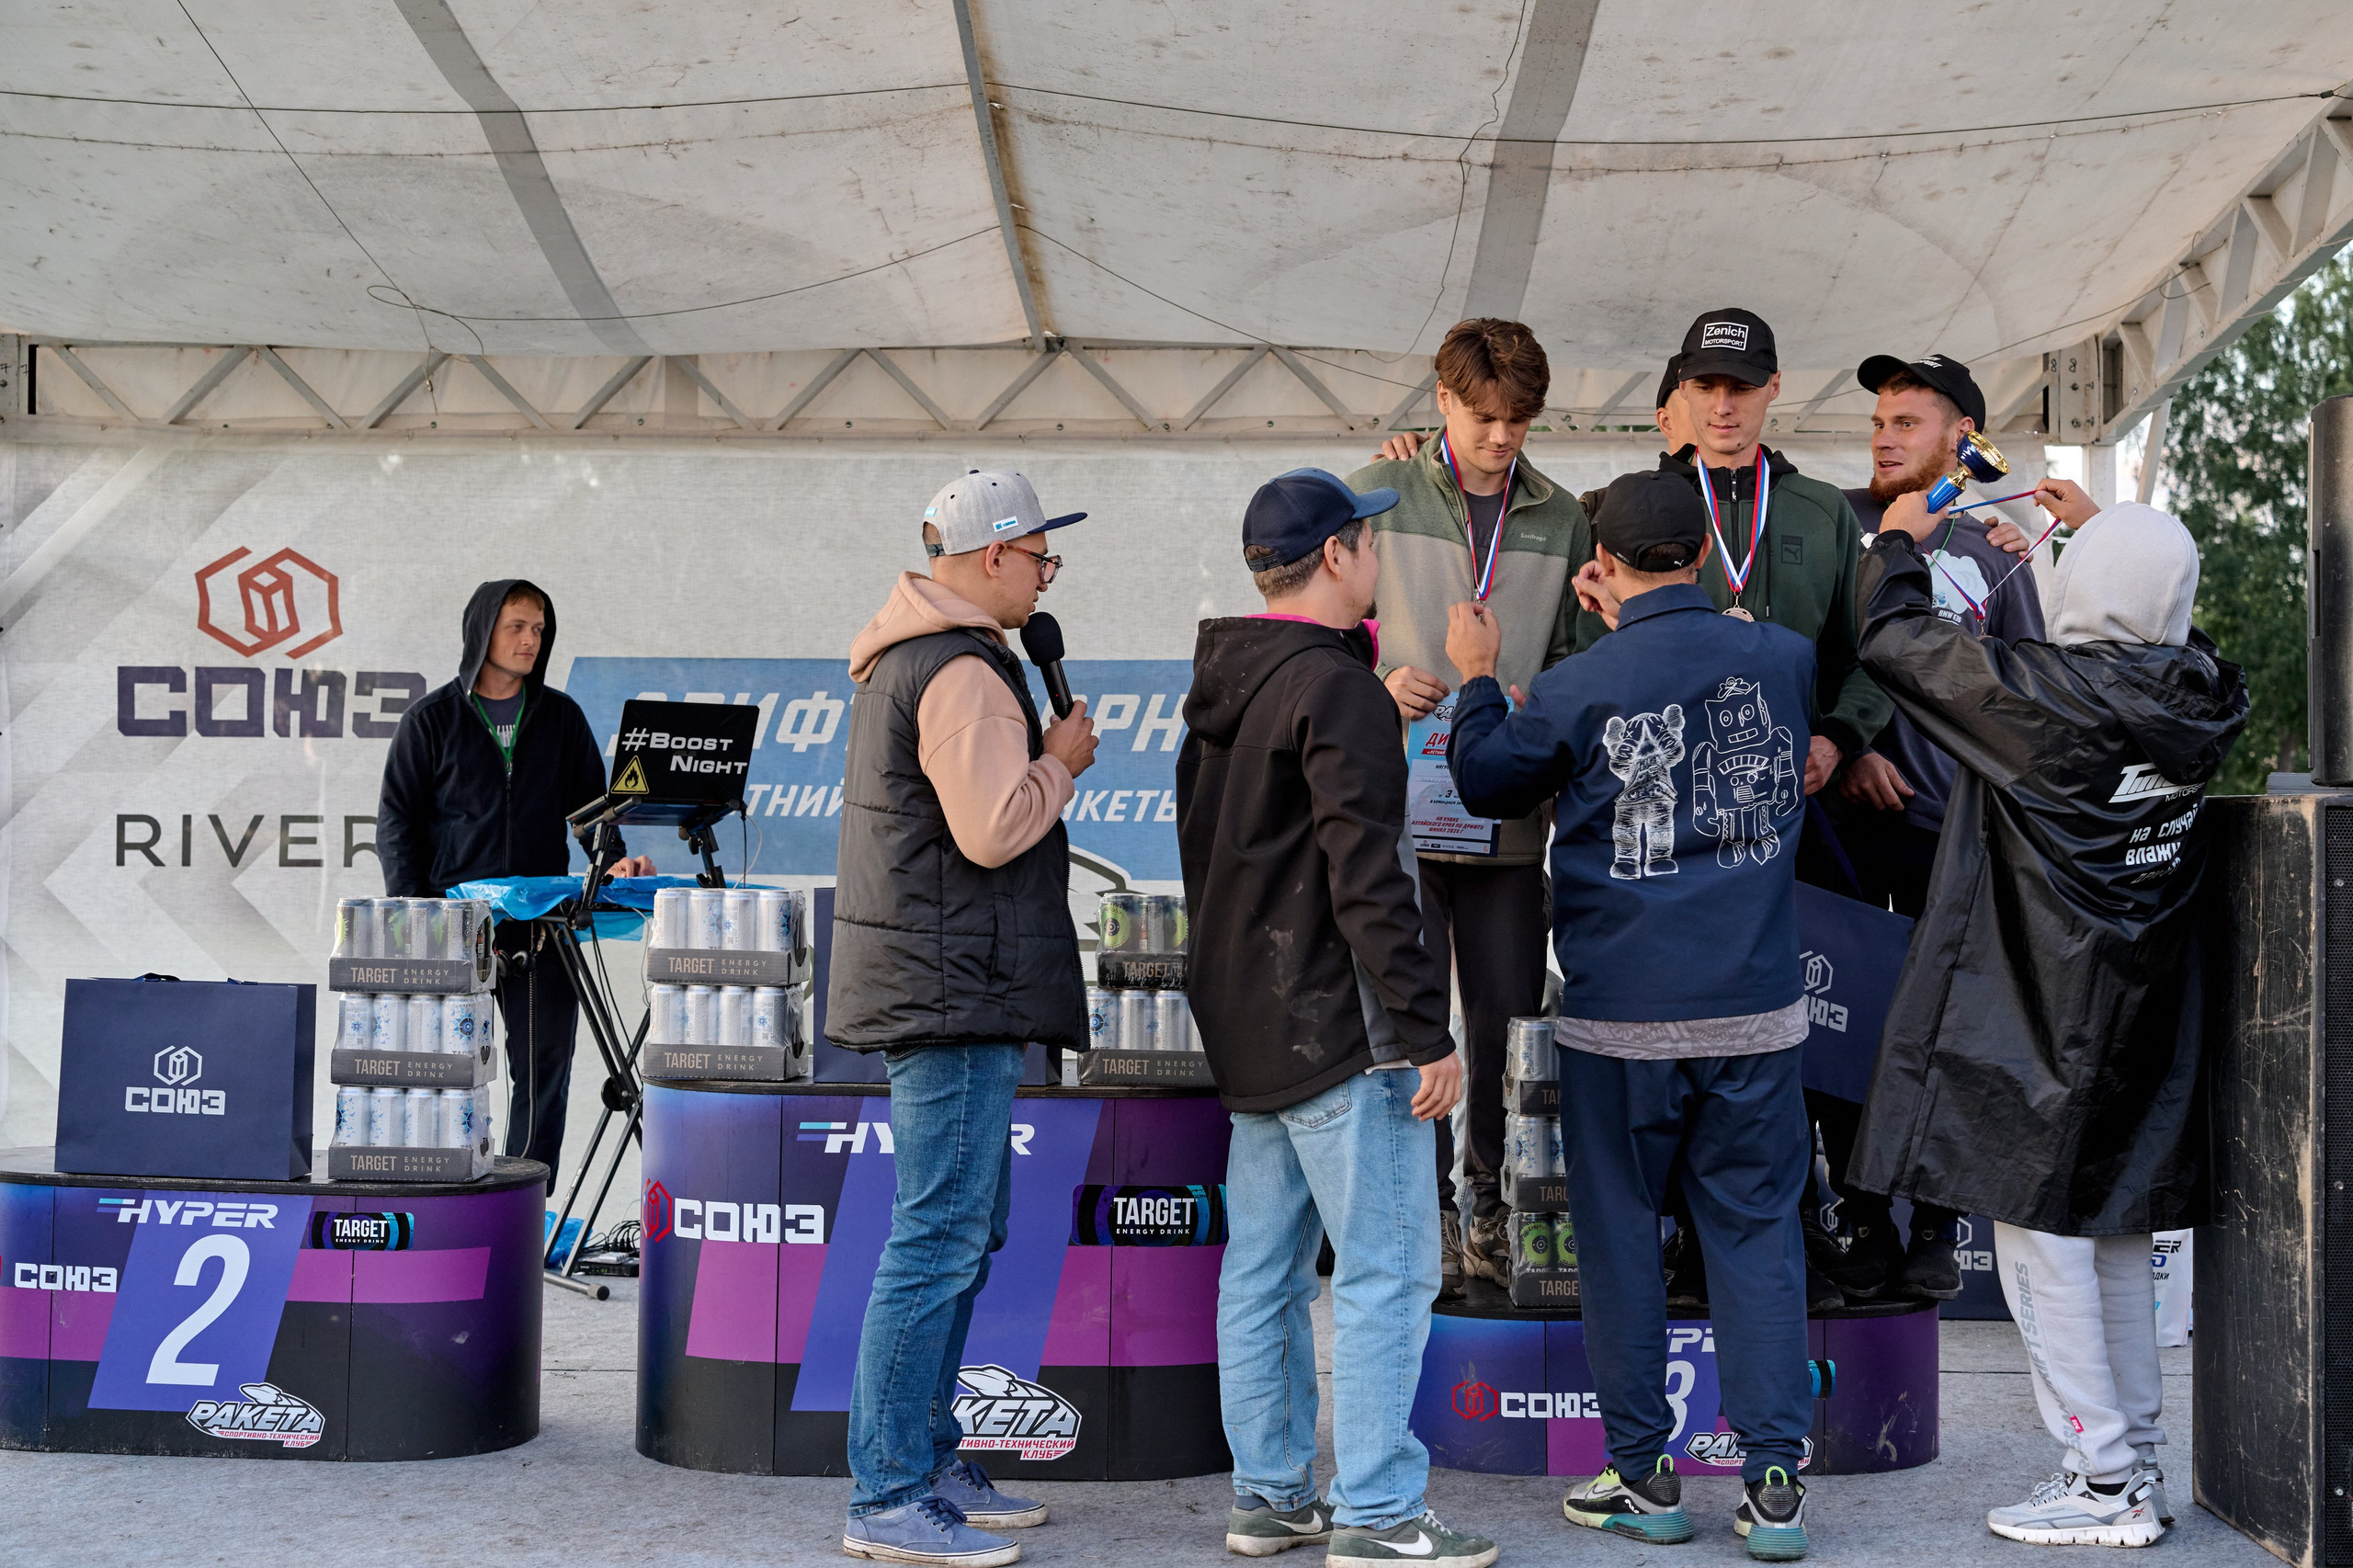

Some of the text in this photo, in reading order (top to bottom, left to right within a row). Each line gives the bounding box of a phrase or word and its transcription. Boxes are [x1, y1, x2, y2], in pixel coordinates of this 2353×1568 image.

[1706, 325, 1745, 338] Zenich
[1705, 338, 1745, 347] MOTORSPORT
[1938, 609, 1954, 620] BMW
[118, 666, 426, 738] СОЮЗ
[2129, 802, 2199, 844] на случай
[668, 957, 767, 974] TARGET ENERGY
[1123, 961, 1170, 978] TARGET
[350, 967, 397, 983] TARGET
[355, 1059, 453, 1076] TARGET ENERGY
[665, 1052, 763, 1069] TARGET ENERGY
[1103, 1058, 1203, 1074] TARGET ENERGY
[125, 1086, 226, 1116] СОЮЗ
[350, 1154, 397, 1171] TARGET
[117, 1199, 278, 1228] HYPER
[1113, 1198, 1195, 1226] TARGET
[334, 1219, 388, 1238] TARGET
[674, 1198, 824, 1244] СОЮЗ
[15, 1262, 118, 1292] СОЮЗ
[1540, 1280, 1579, 1296] TARGE
[2015, 1260, 2038, 1336] SERIES
[145, 1233, 250, 1386] 2
[1501, 1392, 1603, 1418] СОЮЗ
[188, 1403, 323, 1432] РАКЕТА
[953, 1398, 1077, 1435] КЕТА
[224, 1430, 320, 1440] СПОРТИВНО-ТЕХНИЧЕСКИЙ
[961, 1438, 1074, 1449] ТИВНО-ТЕХНИЧЕСКИЙ
[1023, 1450, 1053, 1459] КЛУБ
